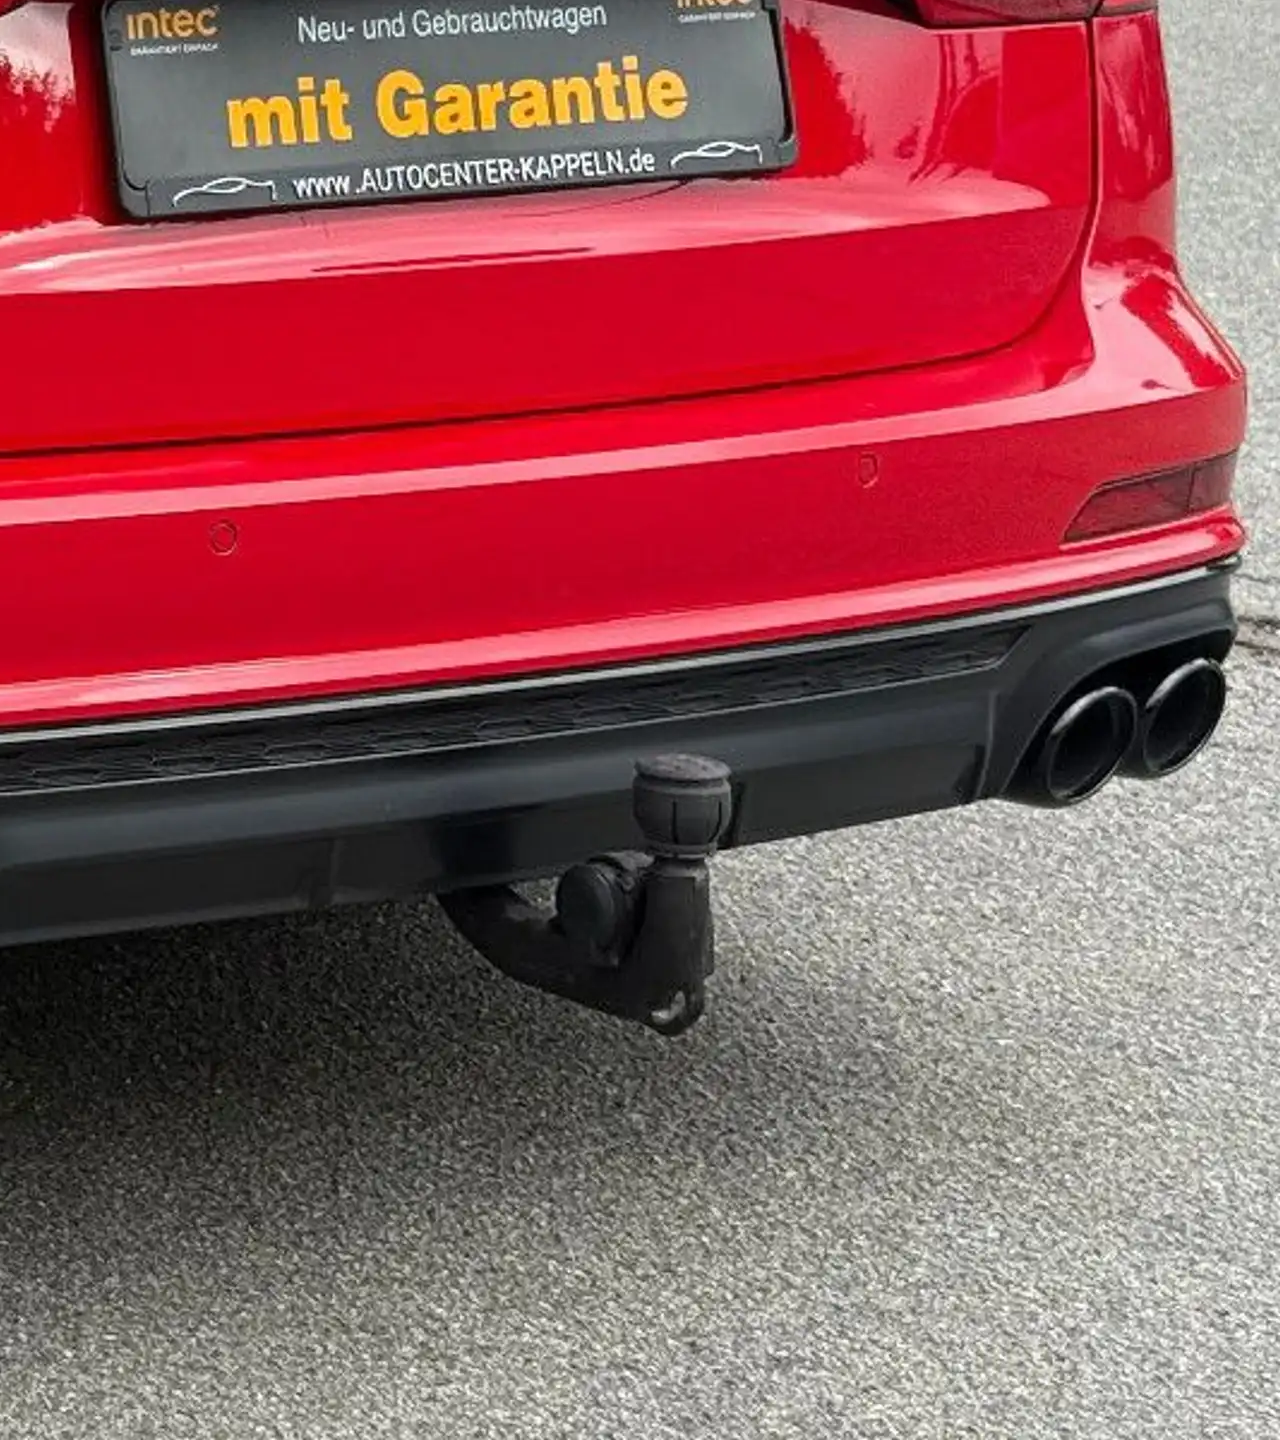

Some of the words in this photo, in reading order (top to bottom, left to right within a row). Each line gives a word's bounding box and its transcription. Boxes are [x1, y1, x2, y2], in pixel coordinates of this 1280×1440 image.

[126, 6, 219, 41] intec
[297, 15, 355, 44] Neu-
[362, 12, 406, 39] und
[412, 3, 608, 38] Gebrauchtwagen
[226, 76, 354, 149] mit
[375, 55, 689, 139] Garantie
